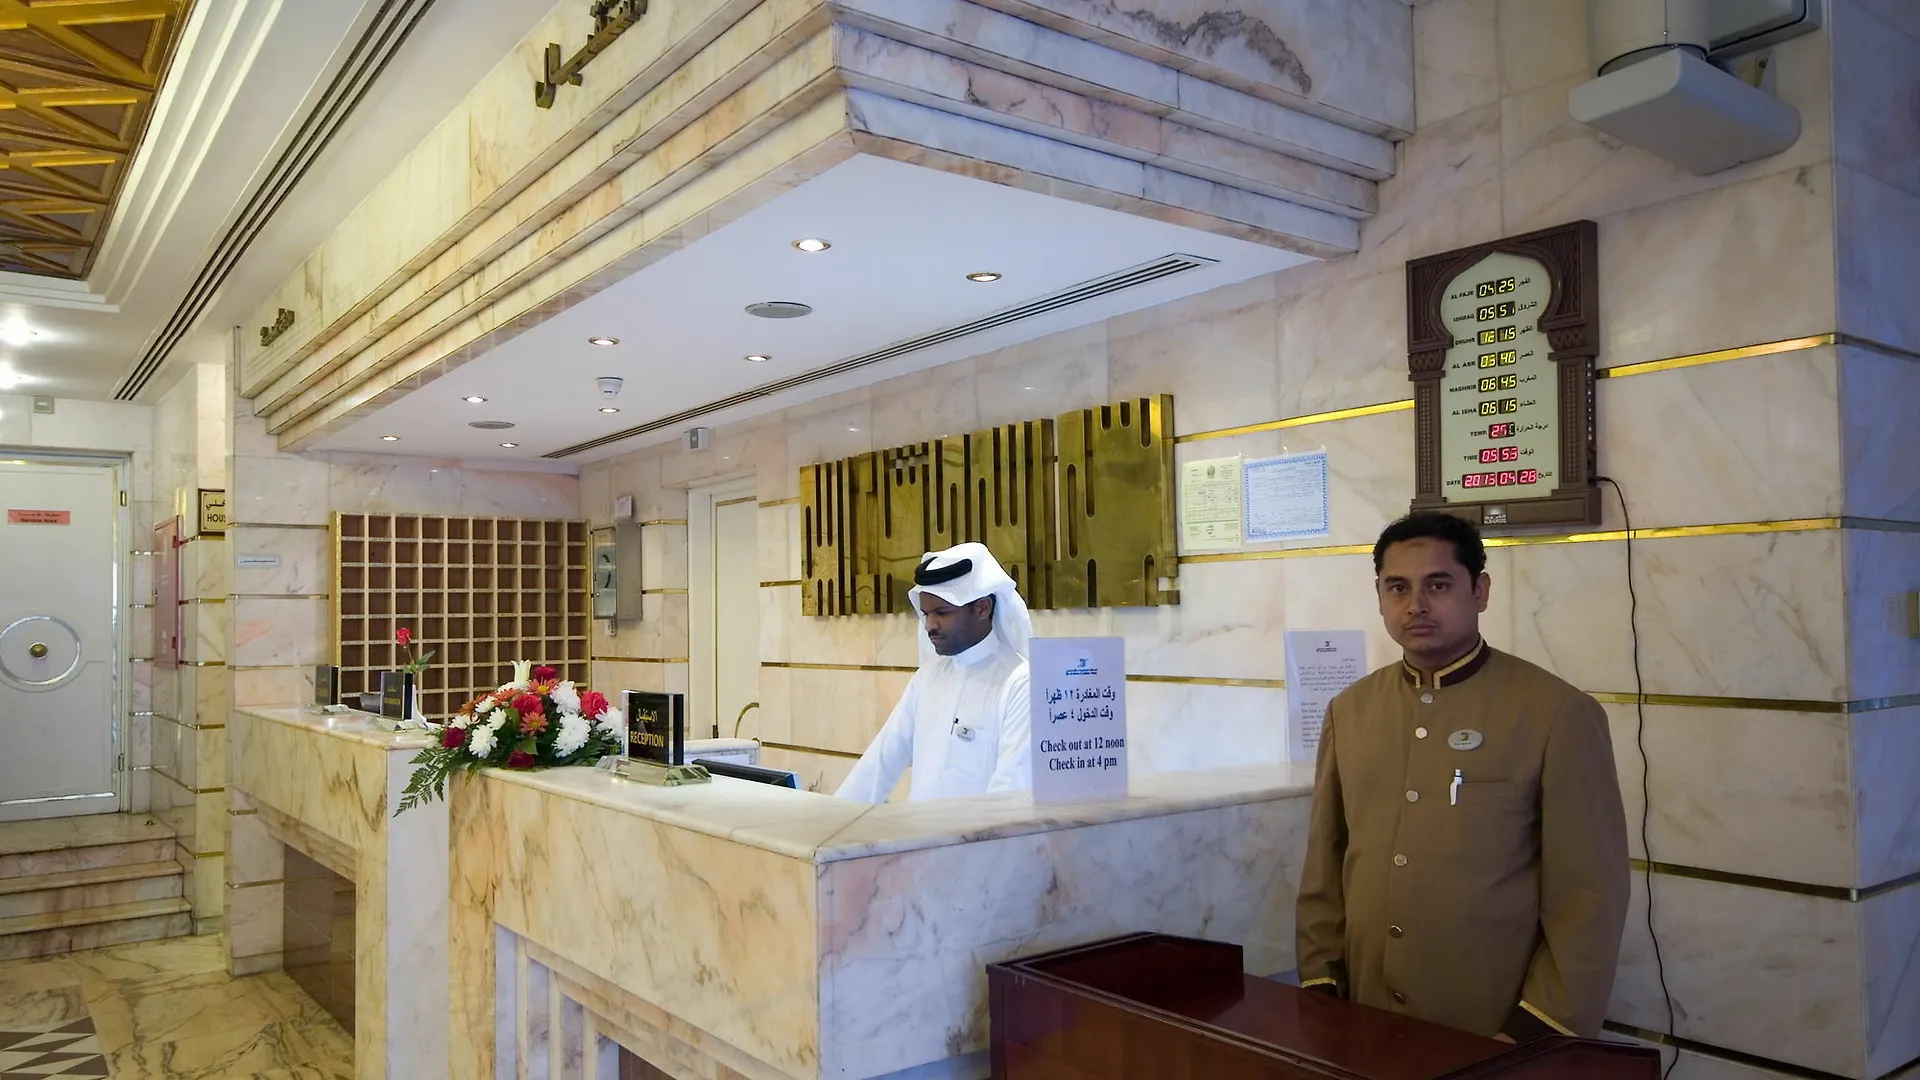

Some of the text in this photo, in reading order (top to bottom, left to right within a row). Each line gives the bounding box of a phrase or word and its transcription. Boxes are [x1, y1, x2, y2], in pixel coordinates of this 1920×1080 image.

[1479, 284, 1494, 297] 04
[1498, 278, 1514, 292] 25
[1480, 306, 1494, 320] 05
[1504, 327, 1516, 340] 15
[1480, 378, 1496, 391] 06
[1501, 376, 1516, 388] 45
[1505, 400, 1516, 411] 15
[1482, 450, 1498, 462] 05
[1500, 472, 1516, 484] 04
[207, 513, 225, 522] HOU
[1064, 689, 1073, 700] ١٢
[1076, 687, 1100, 702] المغادرة
[1101, 685, 1116, 701] وقت
[1077, 707, 1098, 722] الدخول
[1099, 705, 1114, 720] وقت
[630, 730, 664, 748] RECEPTION
[1040, 736, 1124, 752] Check out at 12 noon
[1049, 758, 1075, 771] Check
[1077, 756, 1085, 768] in
[1087, 756, 1095, 768] at
[1104, 757, 1117, 770] pm
